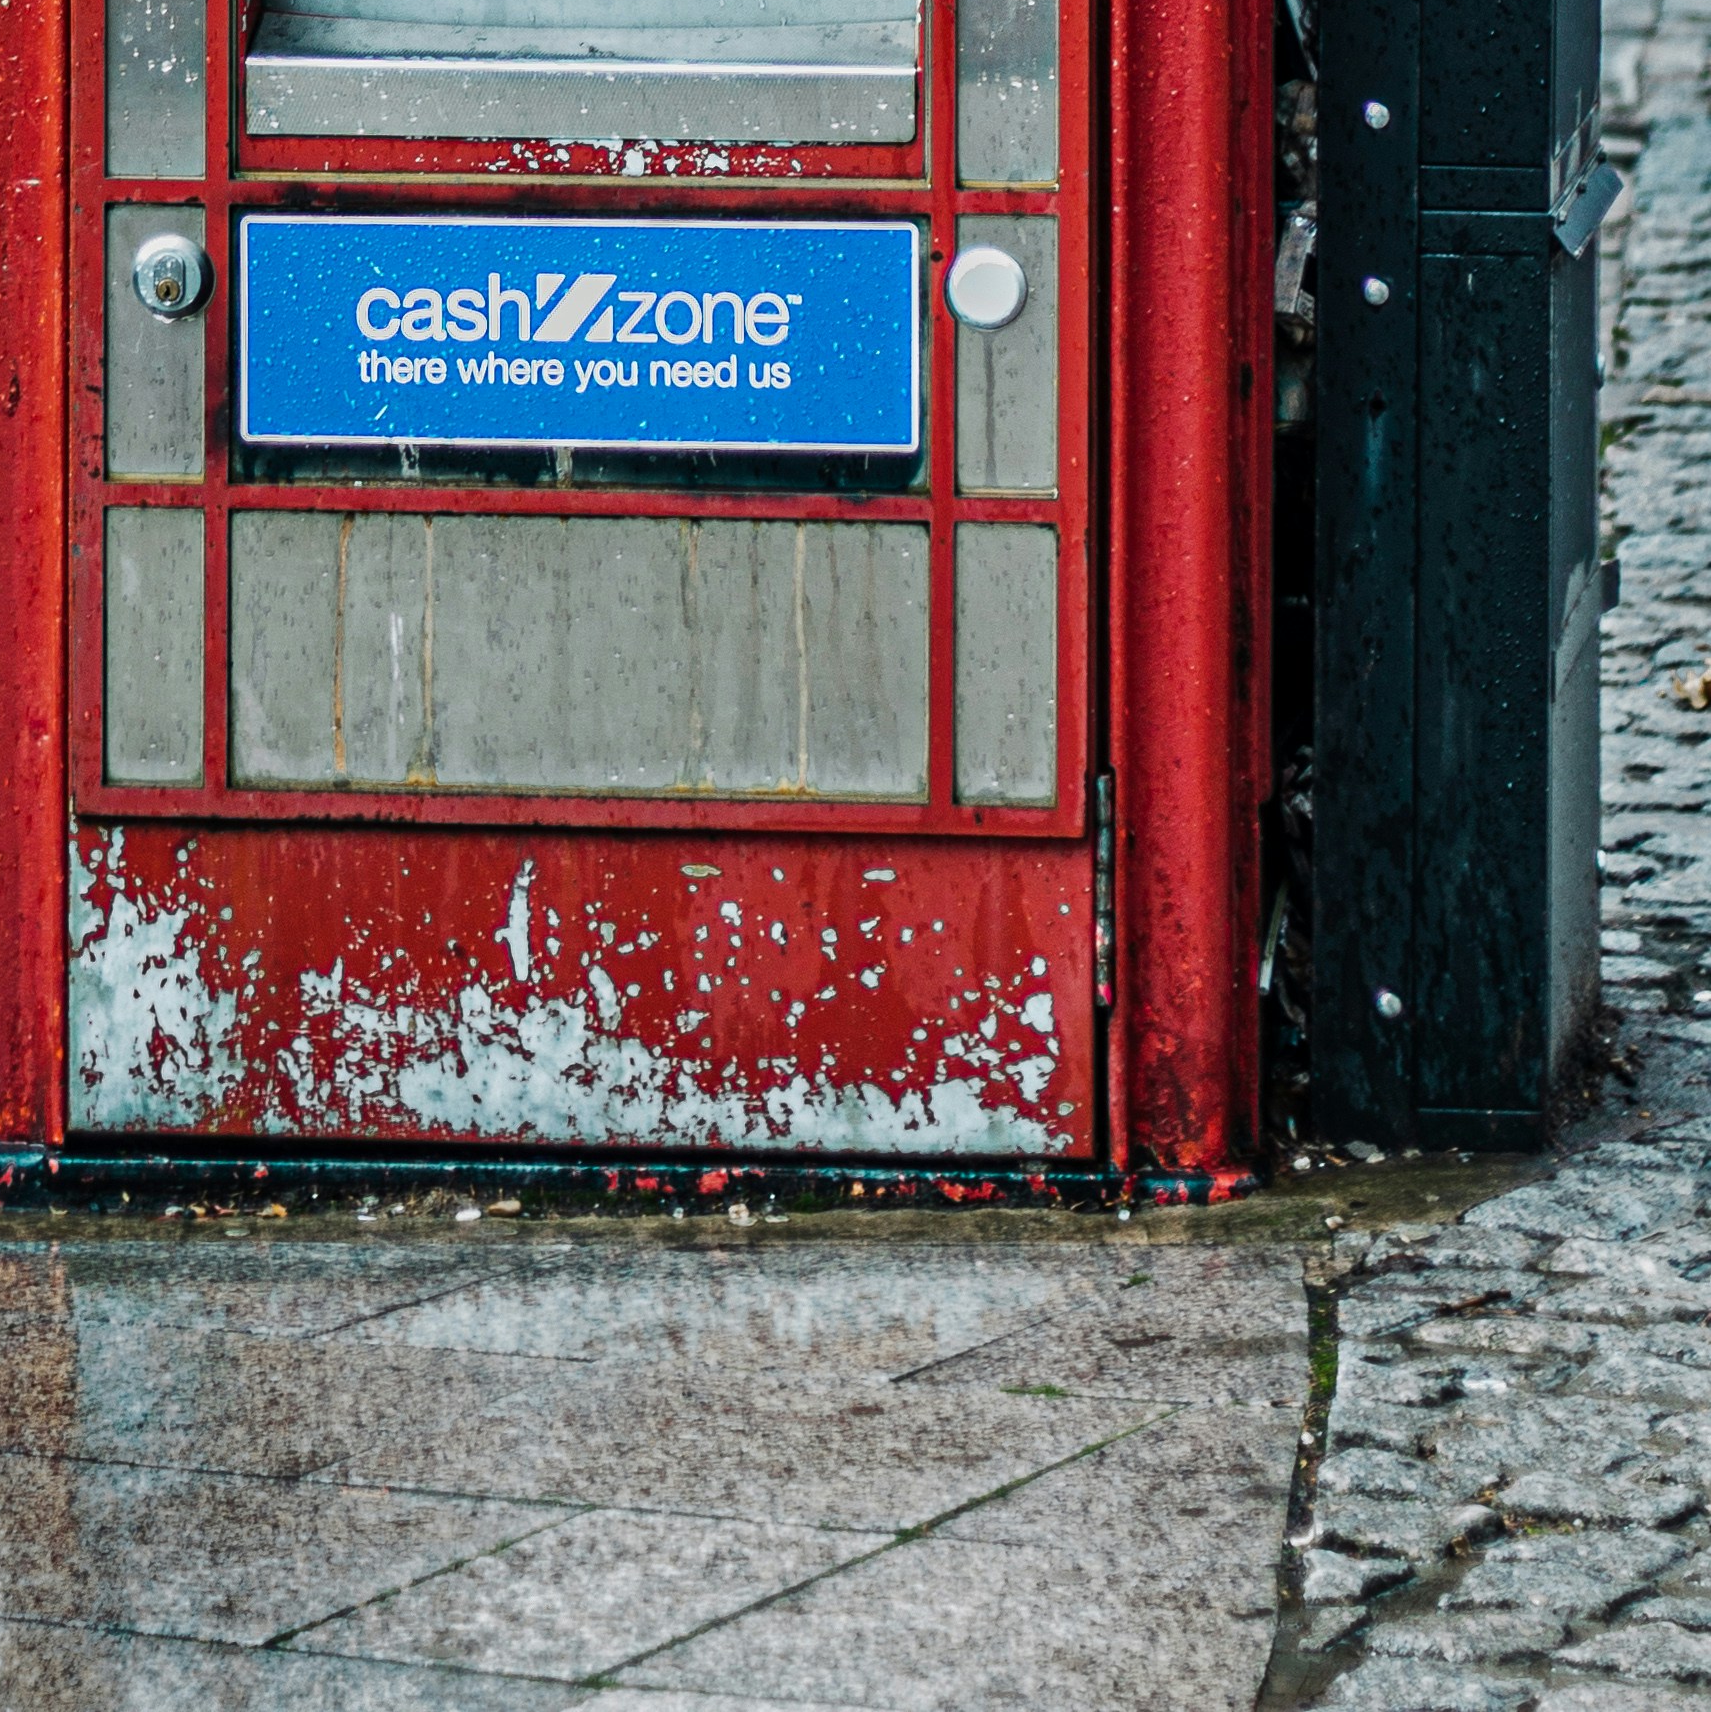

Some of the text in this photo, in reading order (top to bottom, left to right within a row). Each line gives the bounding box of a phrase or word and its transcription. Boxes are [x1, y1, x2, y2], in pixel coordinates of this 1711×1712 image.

[356, 272, 790, 346] cash zone
[357, 348, 792, 394] there where you need us
